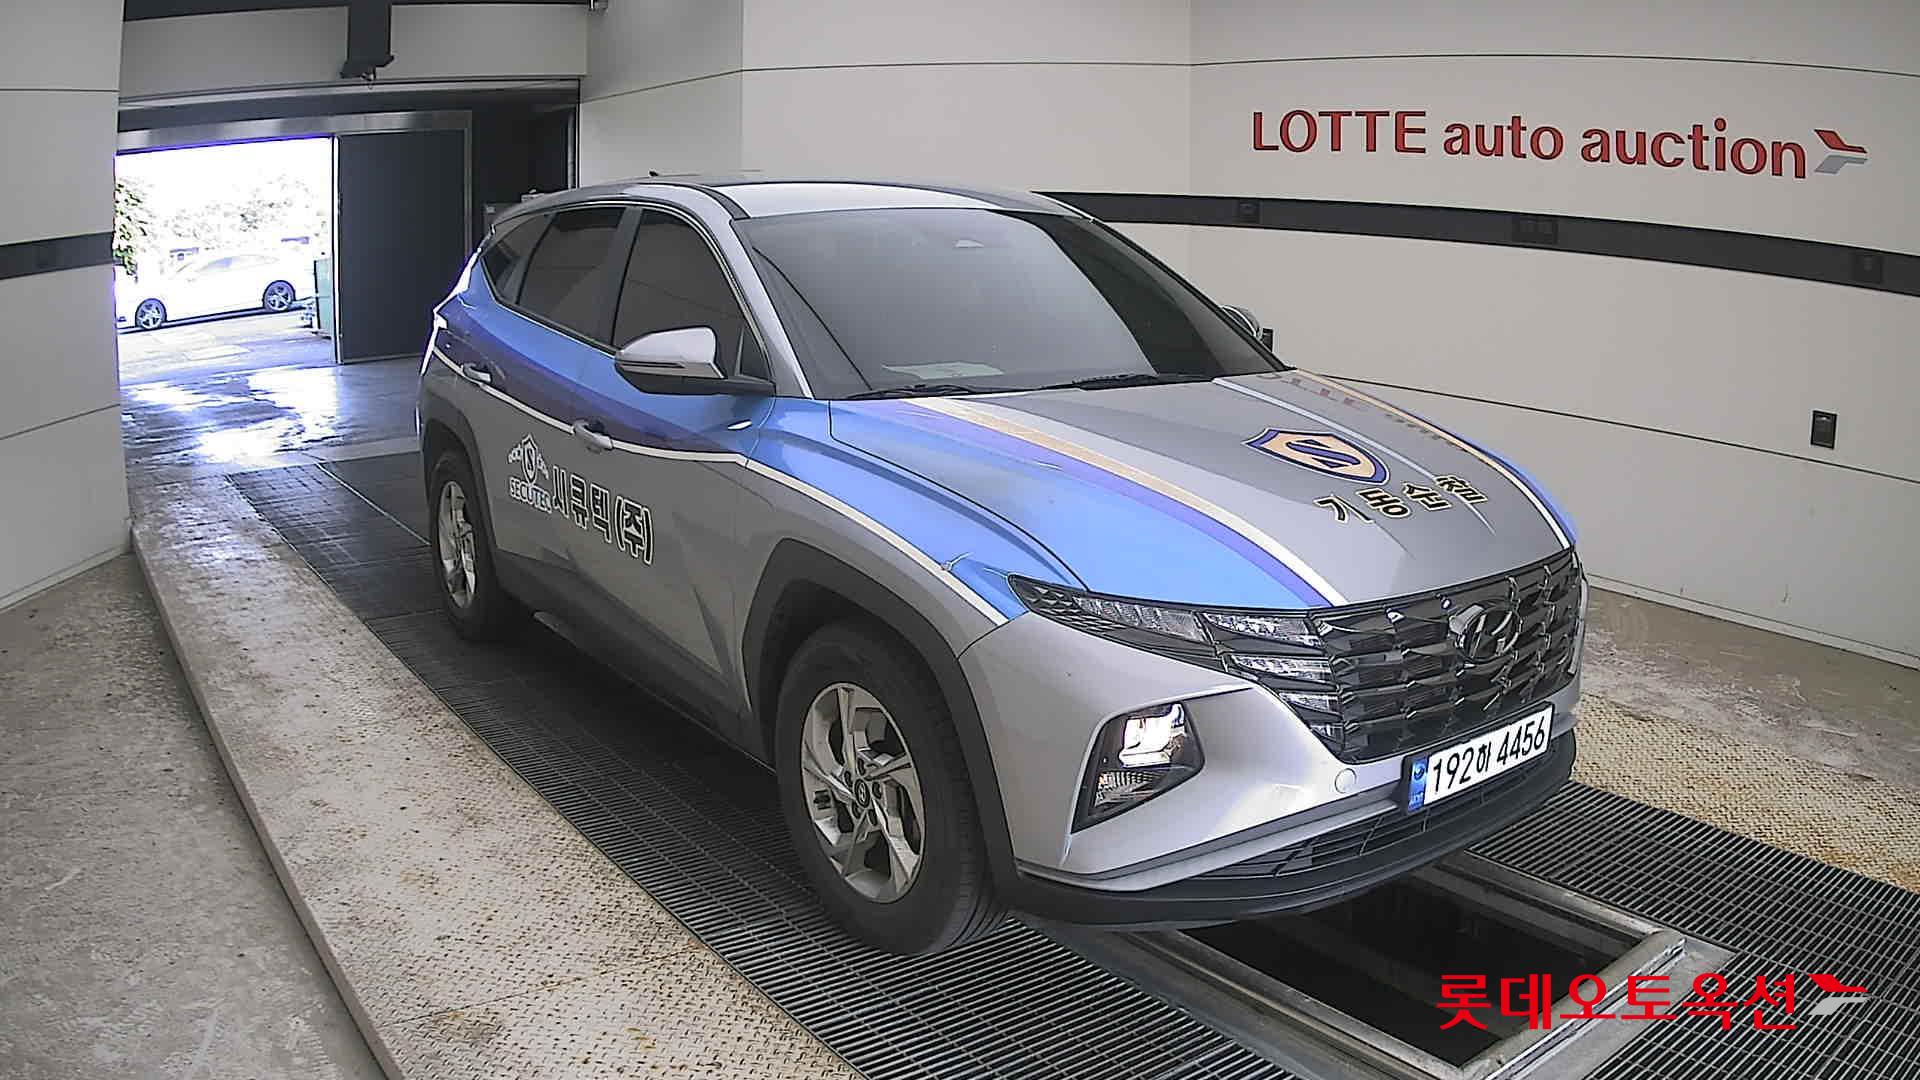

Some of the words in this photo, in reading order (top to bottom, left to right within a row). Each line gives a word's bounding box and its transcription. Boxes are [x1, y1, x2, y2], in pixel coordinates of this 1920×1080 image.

[1252, 110, 1427, 155] LOTTE
[1442, 115, 1566, 161] auto
[1580, 118, 1807, 179] auction
[552, 465, 654, 566] 시큐텍(주)
[1496, 716, 1546, 766] 4456
